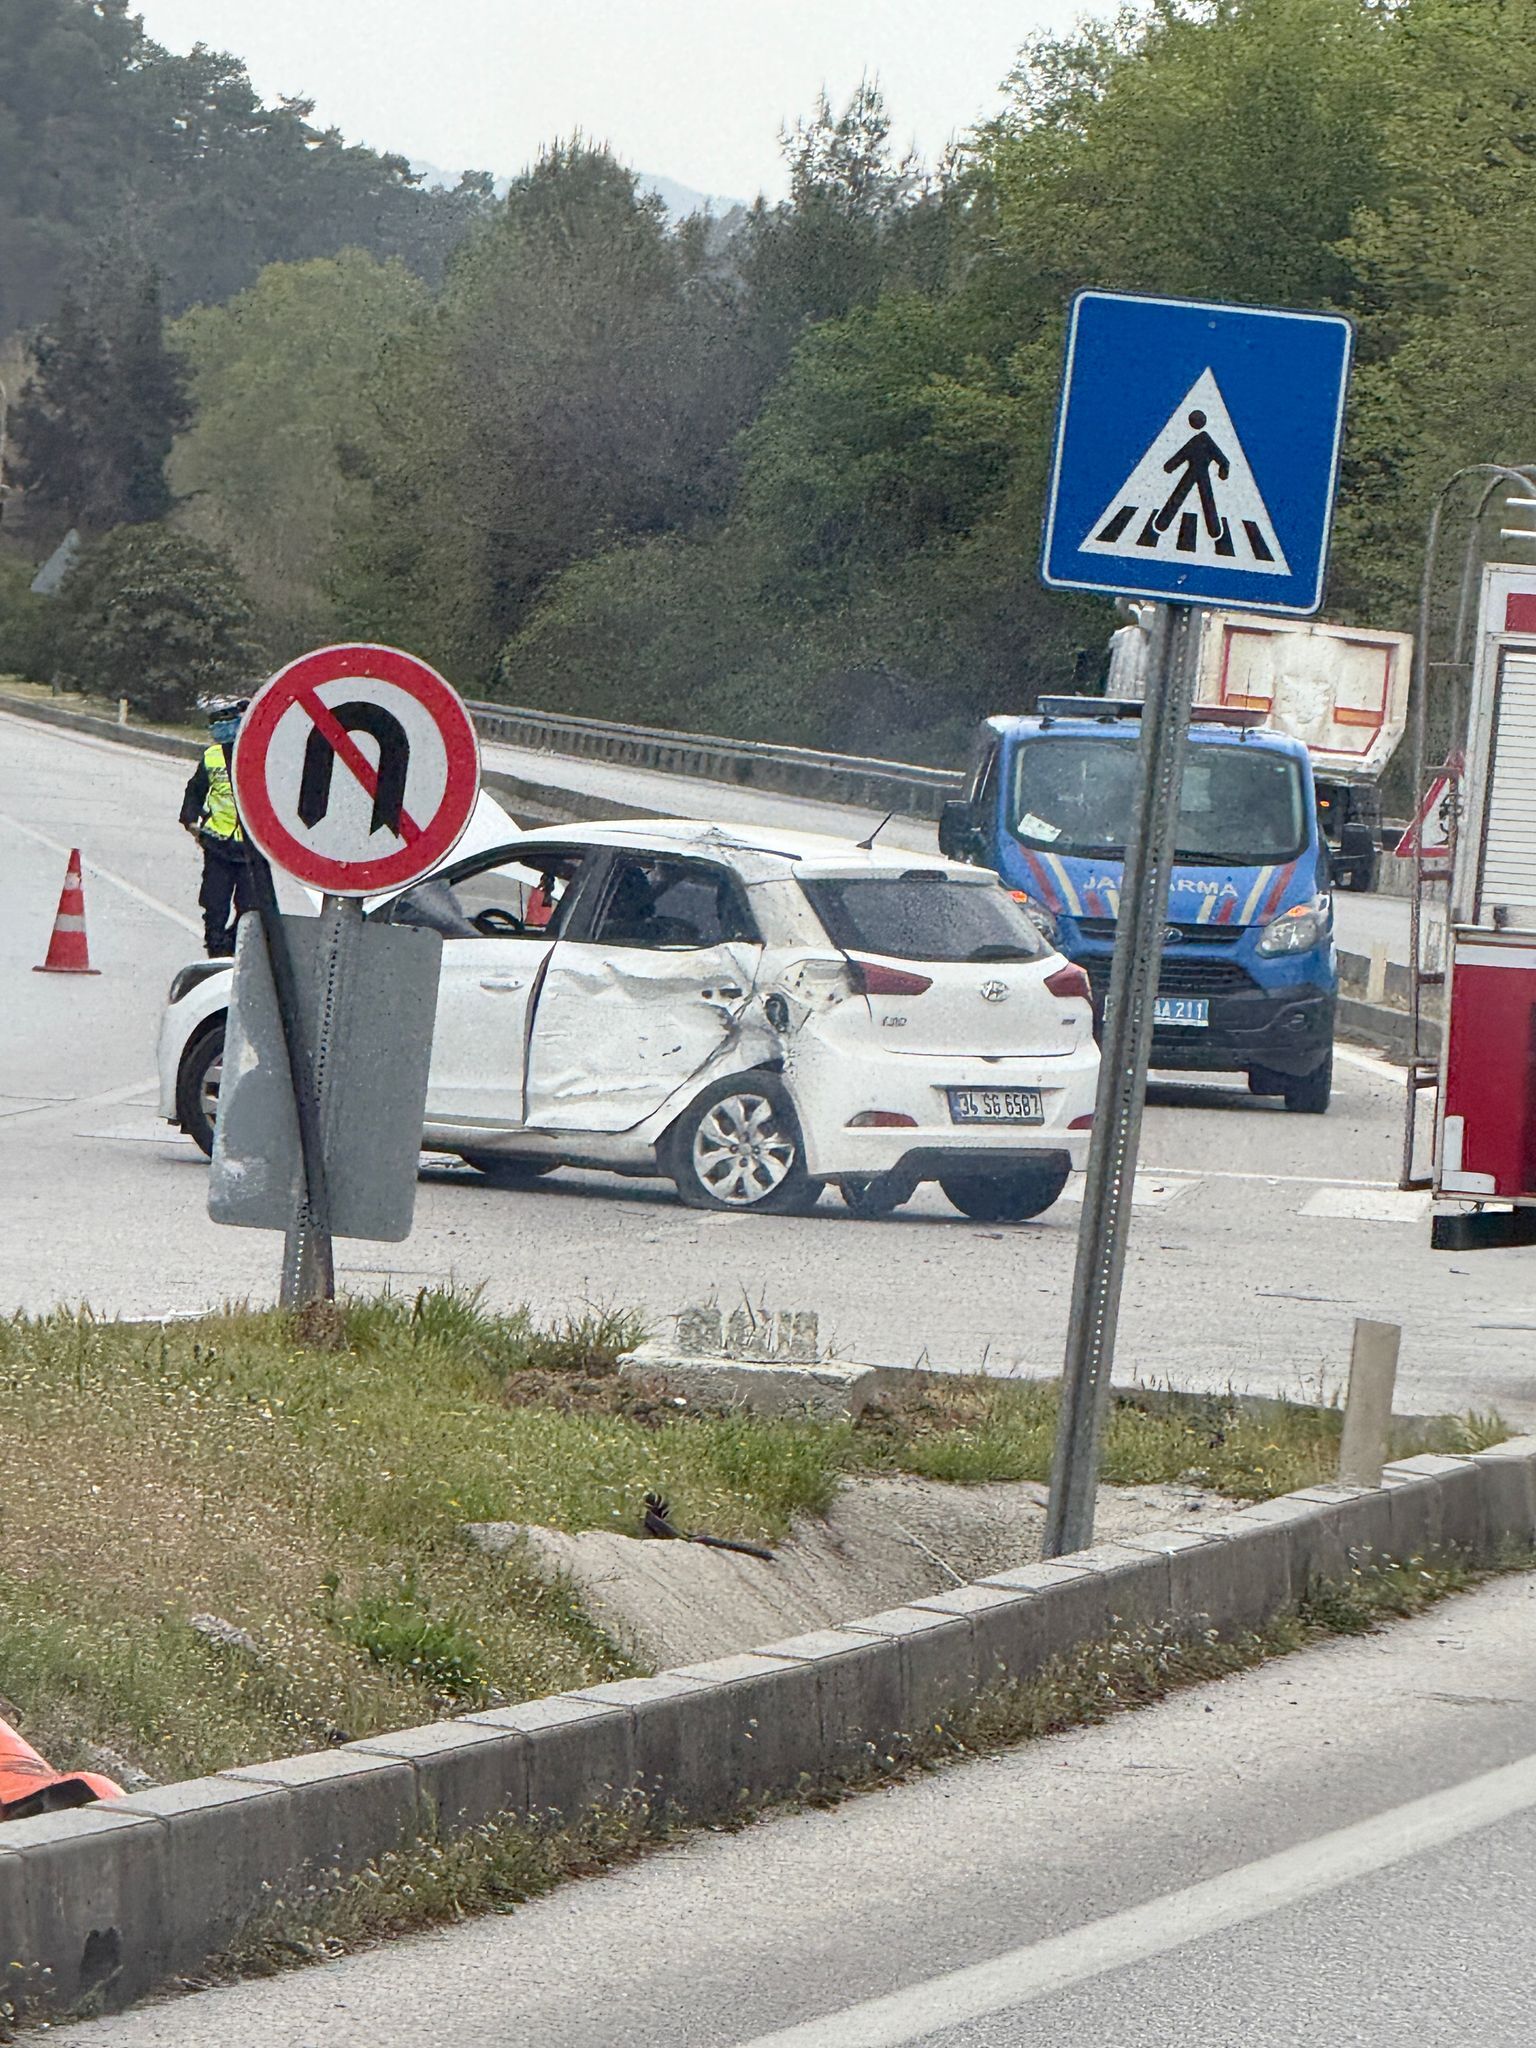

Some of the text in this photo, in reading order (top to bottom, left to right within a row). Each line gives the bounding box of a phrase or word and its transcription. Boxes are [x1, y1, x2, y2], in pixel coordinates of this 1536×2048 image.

[1083, 876, 1238, 897] JARMA
[1176, 1001, 1203, 1019] 211
[959, 1092, 979, 1115] 34
[1005, 1093, 1038, 1116] 6587
